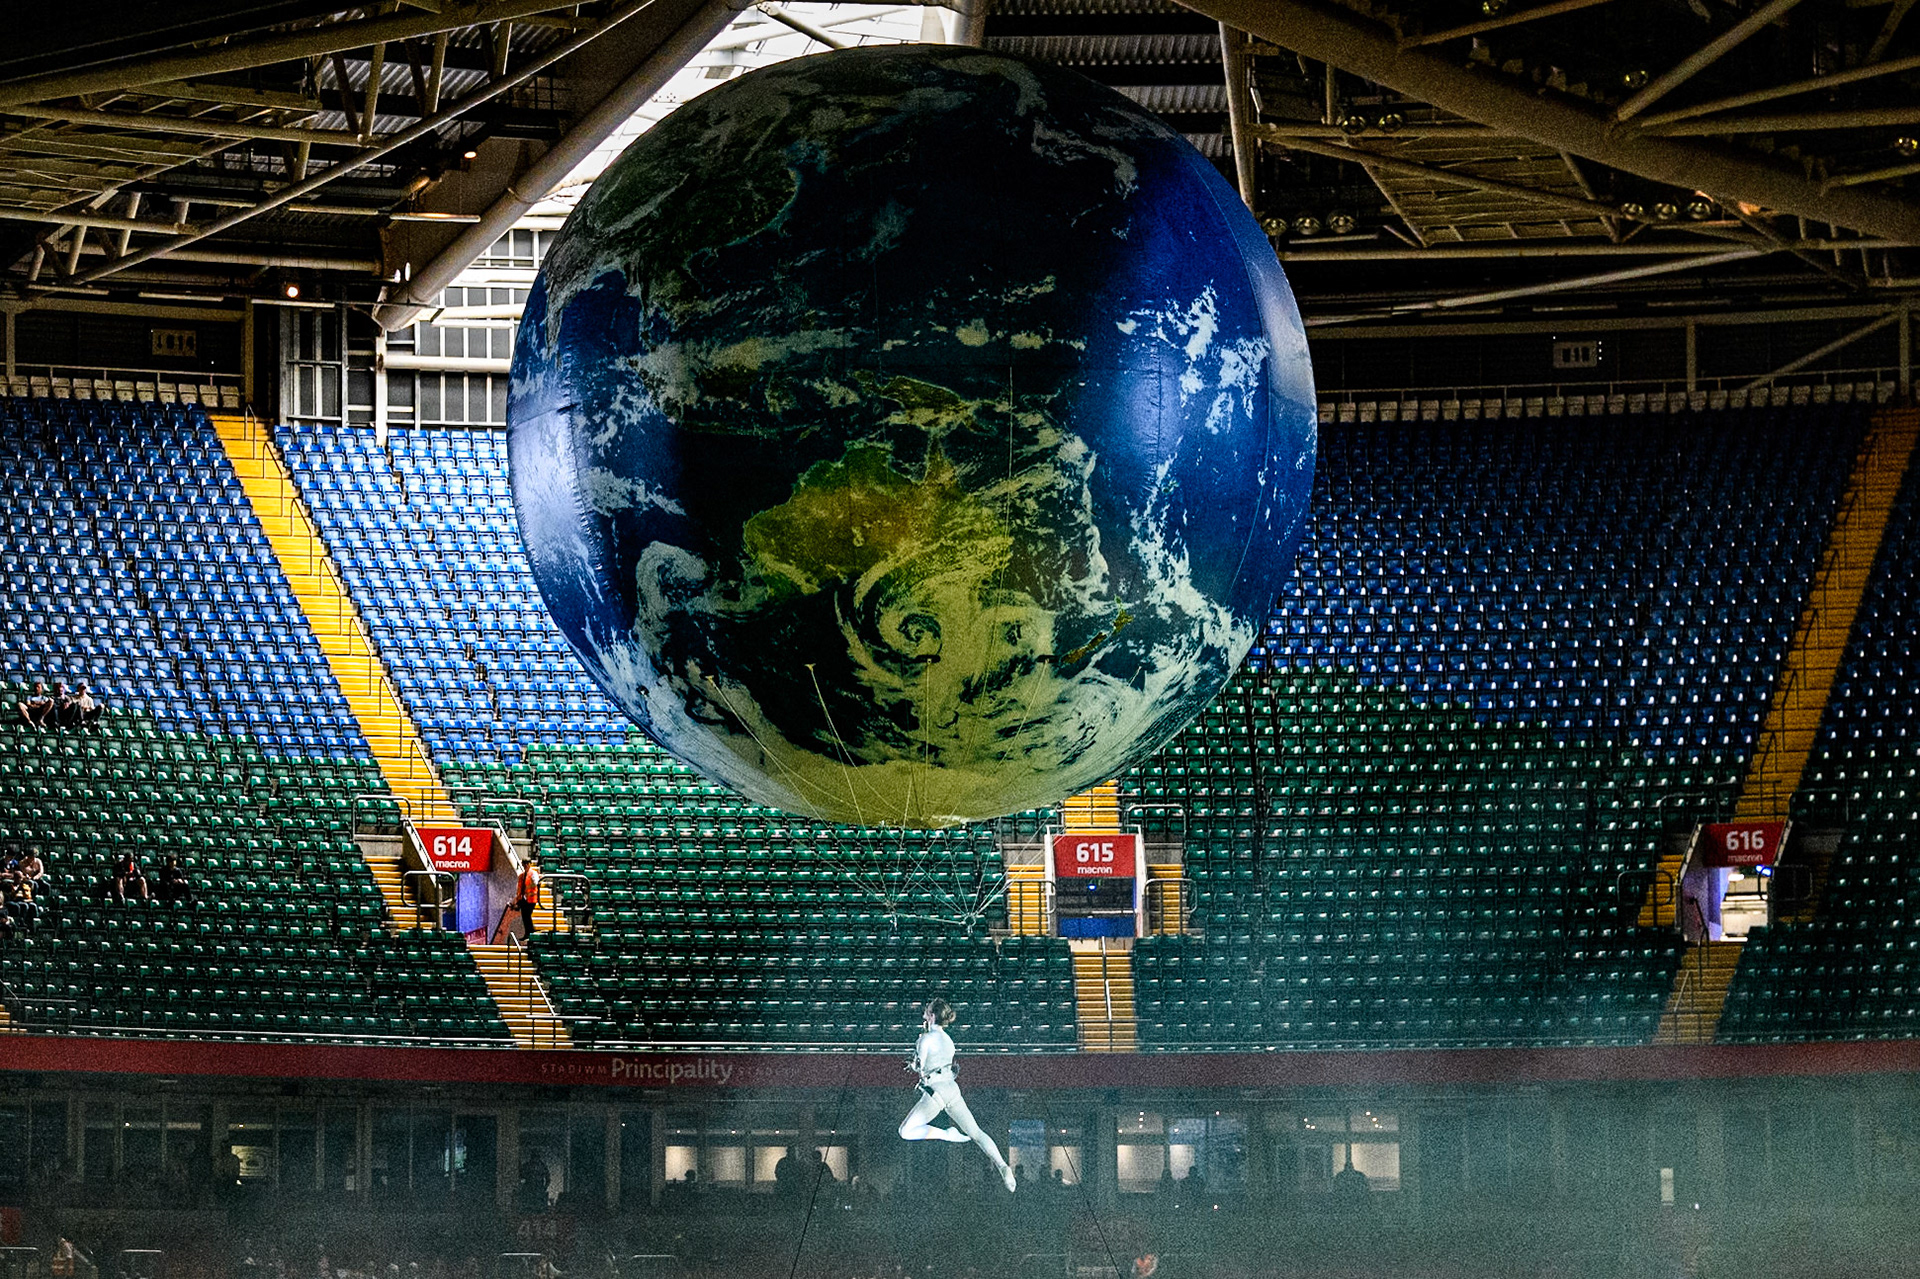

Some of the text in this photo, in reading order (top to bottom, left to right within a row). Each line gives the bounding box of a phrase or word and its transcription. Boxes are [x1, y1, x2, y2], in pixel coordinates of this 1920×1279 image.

[433, 835, 473, 857] 614
[1726, 829, 1765, 851] 616
[1076, 842, 1115, 863] 615
[1727, 853, 1764, 863] macron
[435, 859, 470, 869] macron
[1077, 865, 1113, 875] macron
[541, 1062, 608, 1075] STADIWM
[611, 1057, 734, 1085] Principality
